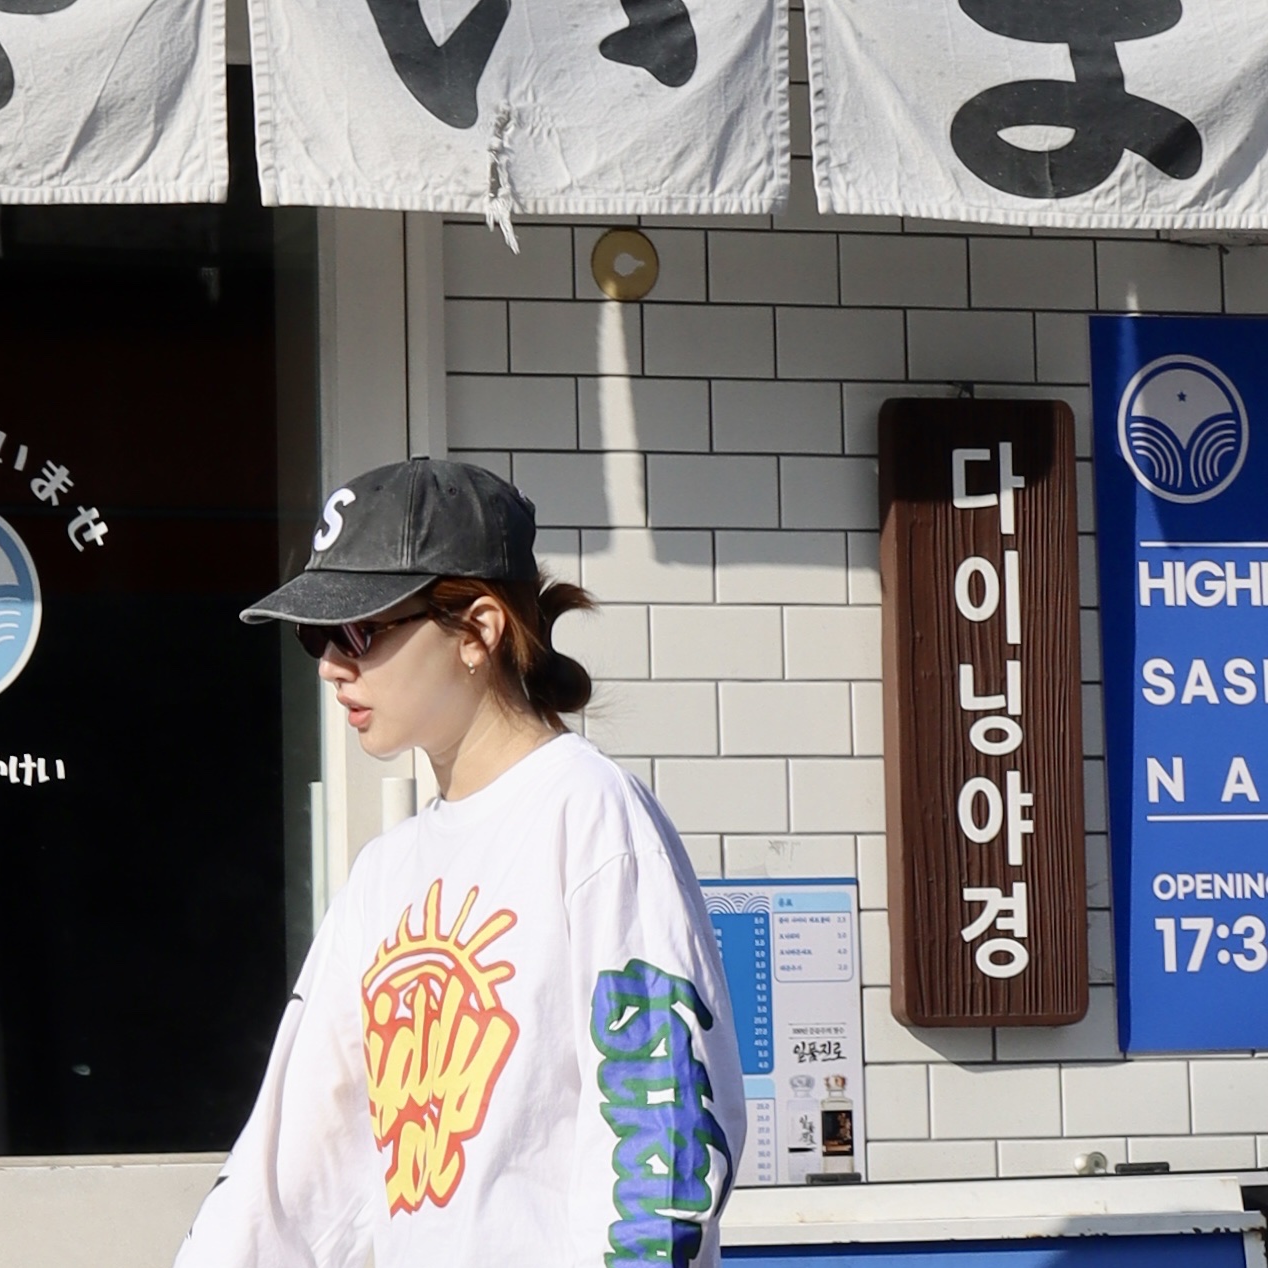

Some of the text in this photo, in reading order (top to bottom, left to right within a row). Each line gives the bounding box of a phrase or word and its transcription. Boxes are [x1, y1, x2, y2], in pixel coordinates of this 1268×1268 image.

[313, 488, 357, 552] S
[1138, 561, 1268, 607] HIGH
[951, 442, 1035, 979] 다이닝야경
[793, 1041, 847, 1063] 일품진로
